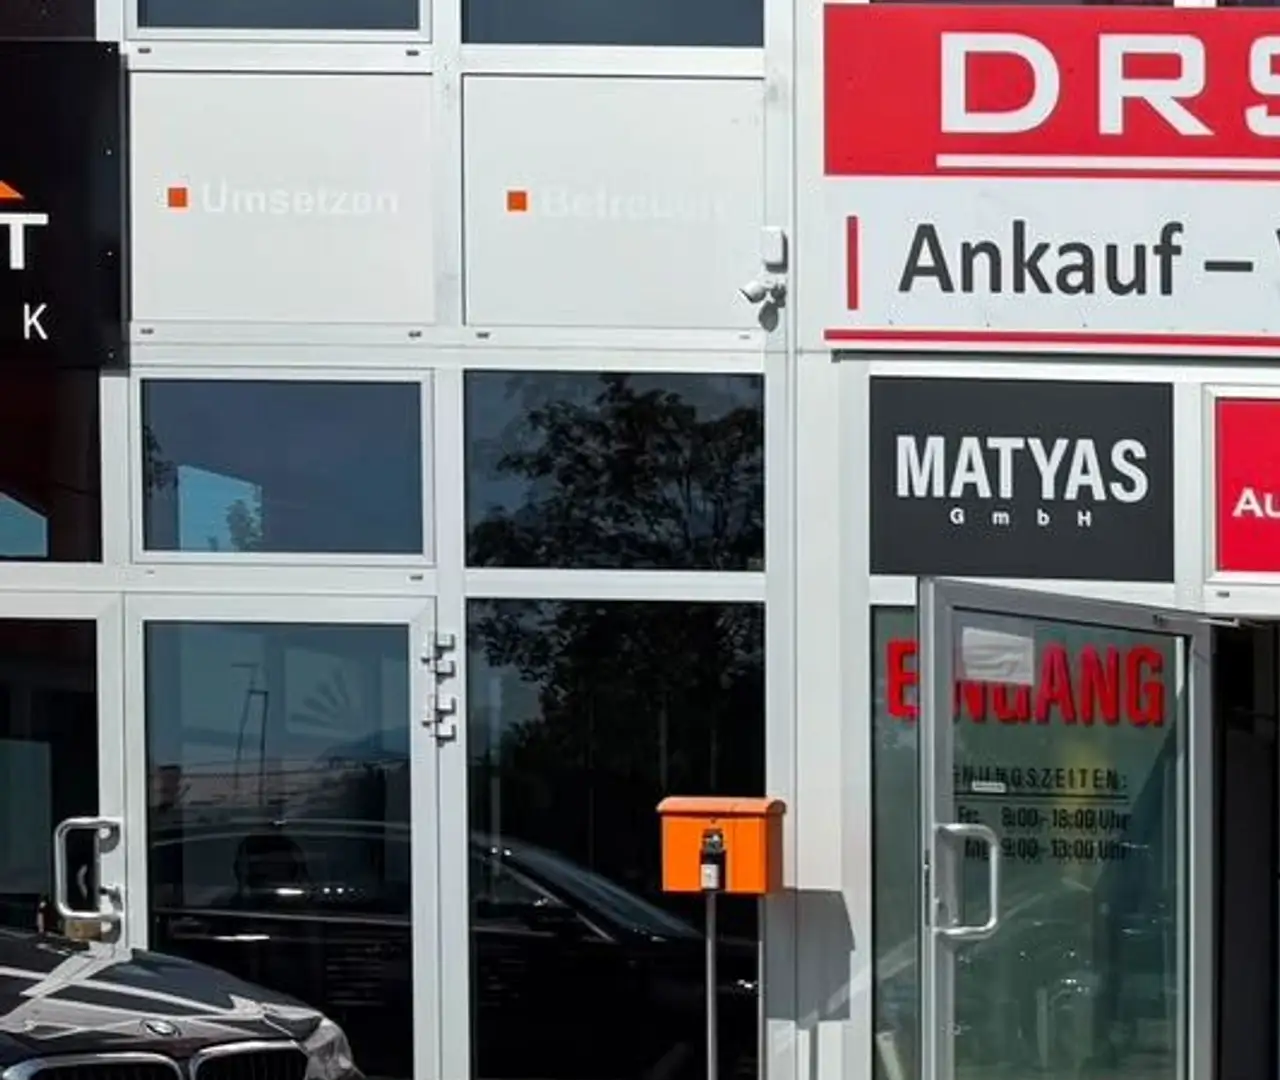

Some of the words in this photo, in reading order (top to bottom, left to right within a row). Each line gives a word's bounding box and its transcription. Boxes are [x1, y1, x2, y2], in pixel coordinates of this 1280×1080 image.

[898, 220, 1184, 296] Ankauf
[896, 434, 1149, 503] MATYAS
[950, 507, 1092, 528] GmbH
